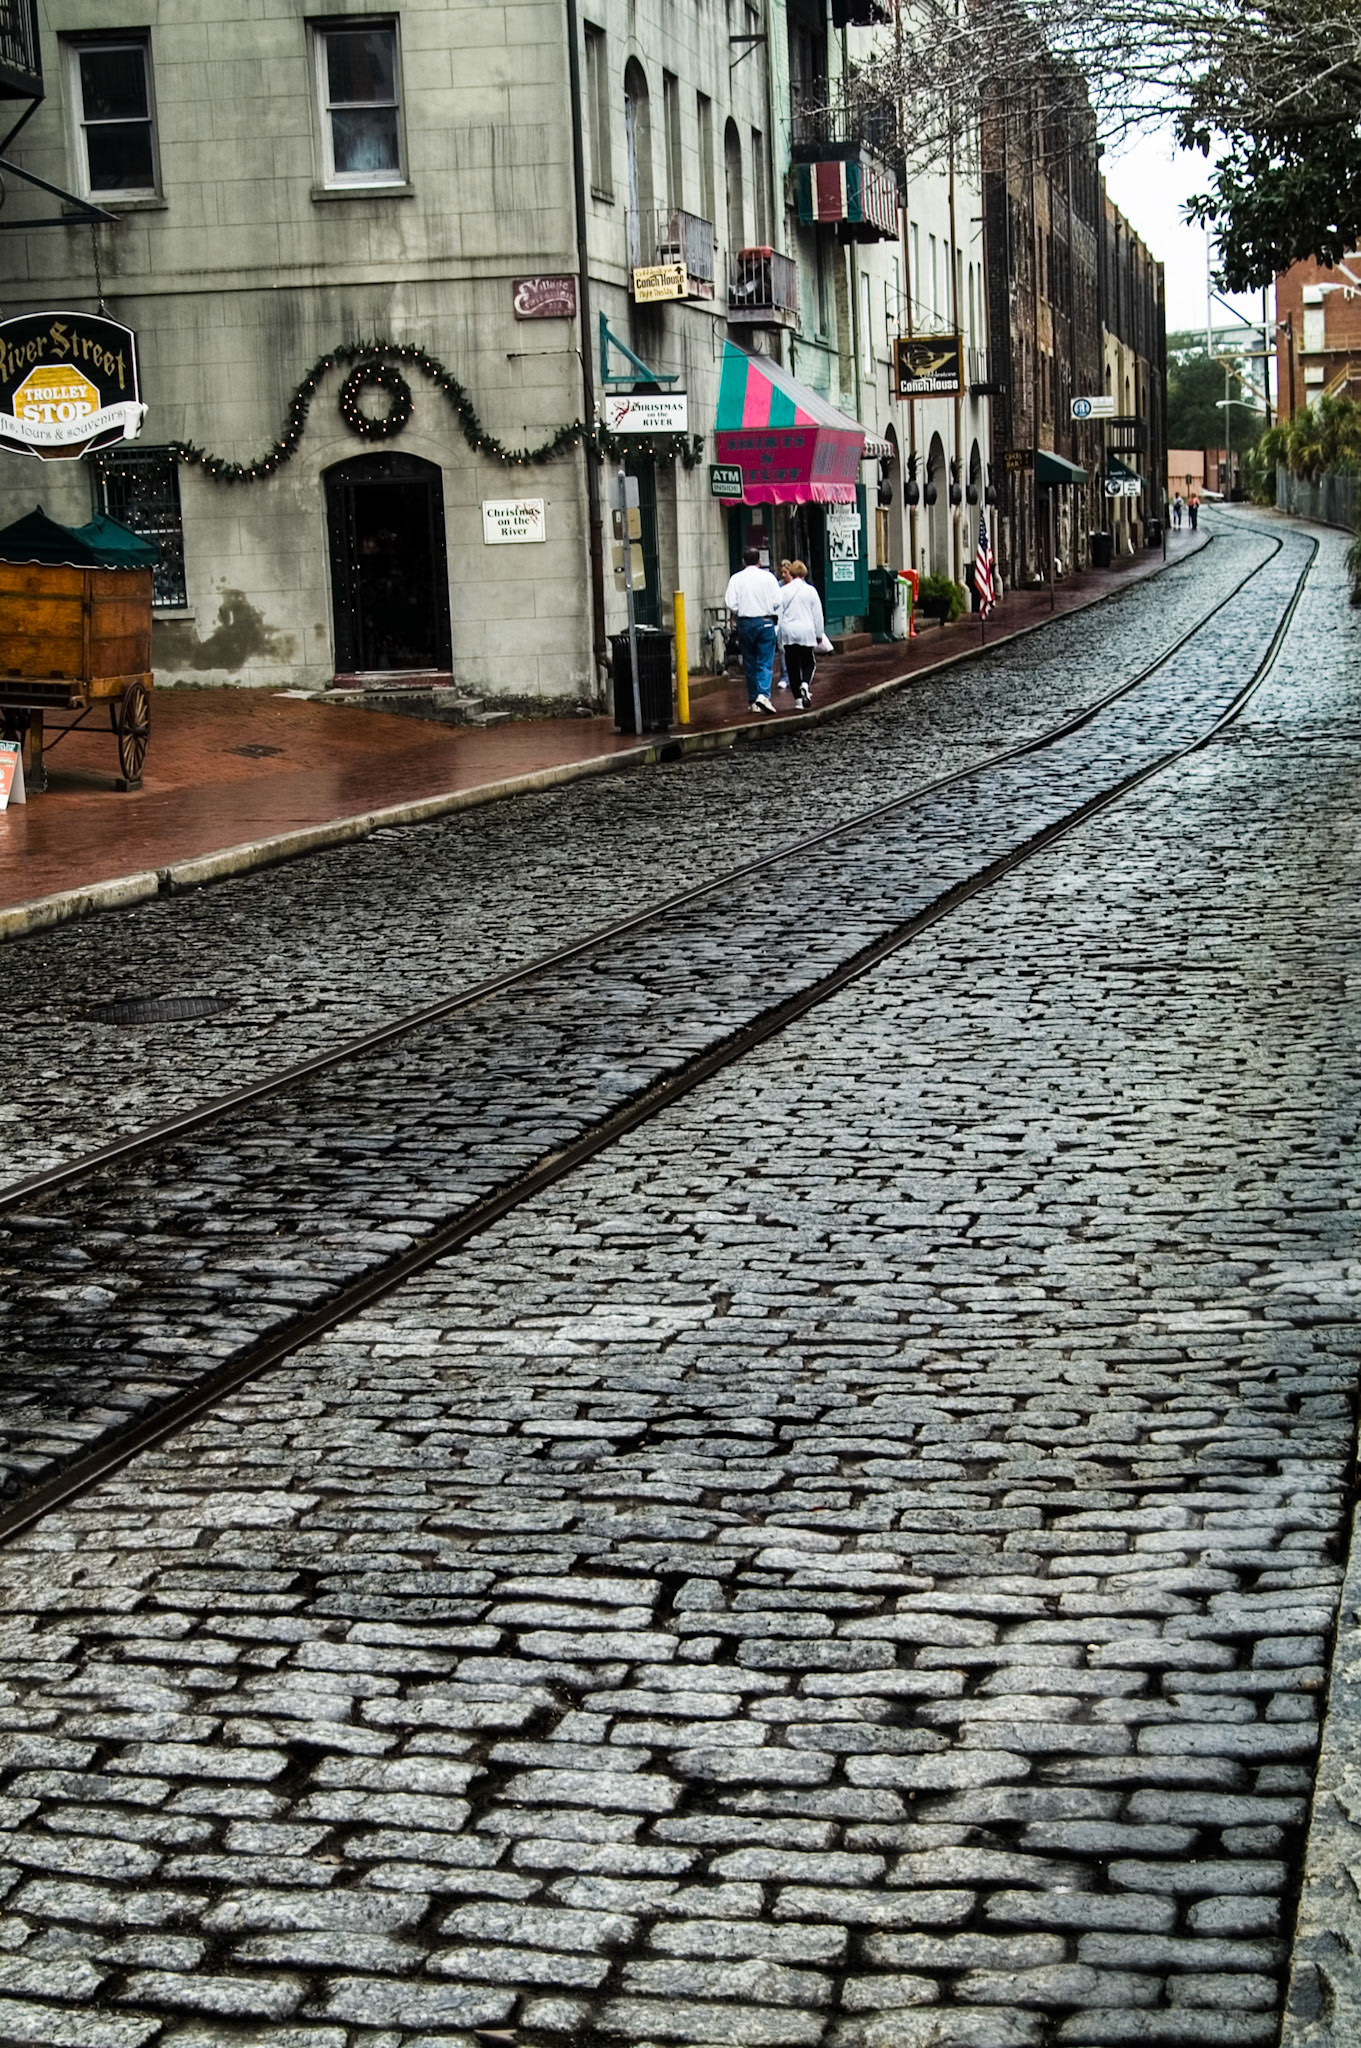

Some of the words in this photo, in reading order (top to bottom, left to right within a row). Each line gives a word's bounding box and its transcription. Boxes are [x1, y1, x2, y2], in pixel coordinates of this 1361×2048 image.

[636, 275, 660, 289] Conch
[661, 273, 684, 287] House
[0, 336, 47, 383] River
[49, 321, 126, 390] Street
[900, 378, 929, 393] Conch
[929, 377, 958, 392] House
[24, 385, 88, 401] TROLLEY
[23, 401, 92, 424] STOP
[21, 424, 52, 440] tours
[54, 428, 63, 440] &
[67, 410, 125, 436] souvenirs
[643, 418, 673, 426] RIVER
[727, 436, 804, 449] SHIRTS
[712, 470, 739, 482] ATM
[743, 468, 801, 480] TUFF
[713, 484, 739, 492] INSIDE
[487, 507, 541, 517] Christmas
[514, 517, 531, 526] the
[501, 527, 527, 536] River
